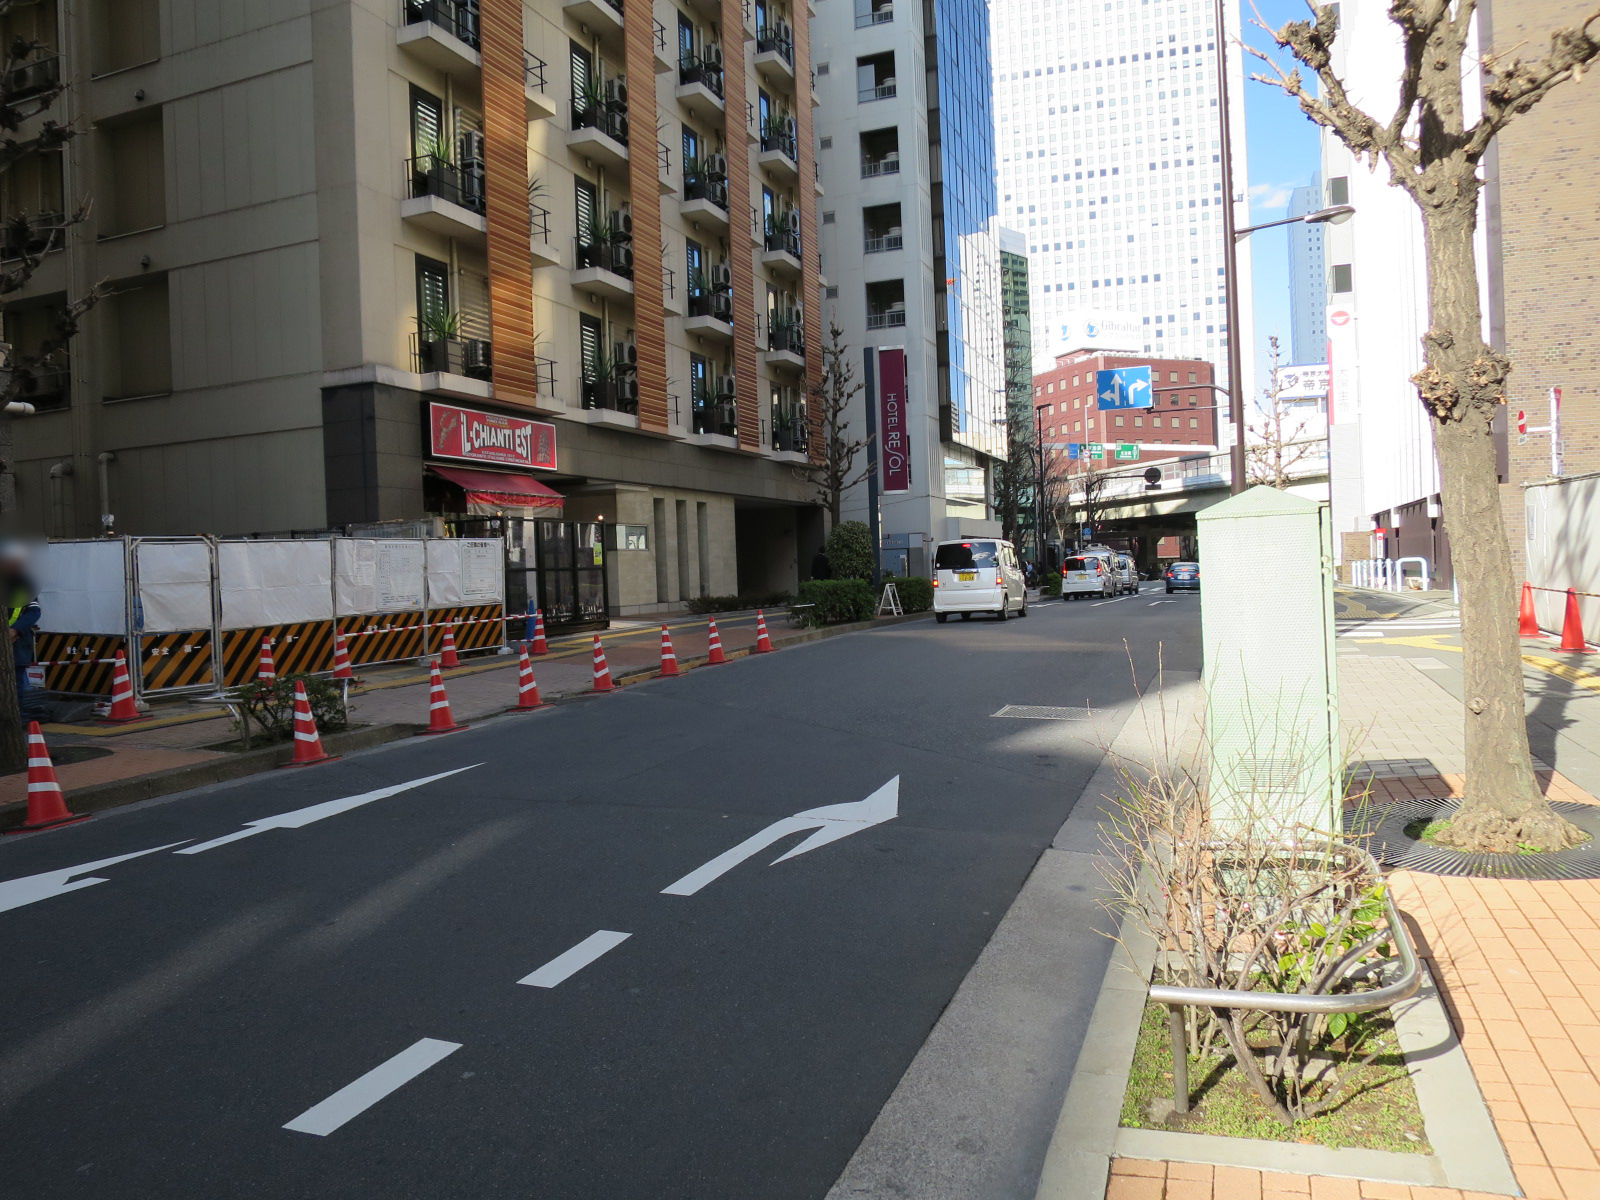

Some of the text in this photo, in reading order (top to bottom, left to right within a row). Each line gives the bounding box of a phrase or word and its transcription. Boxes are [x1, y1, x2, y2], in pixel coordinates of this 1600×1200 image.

[1101, 319, 1142, 332] Gibraltar
[515, 424, 532, 464] EST
[884, 393, 905, 476] HOTEL RESOL
